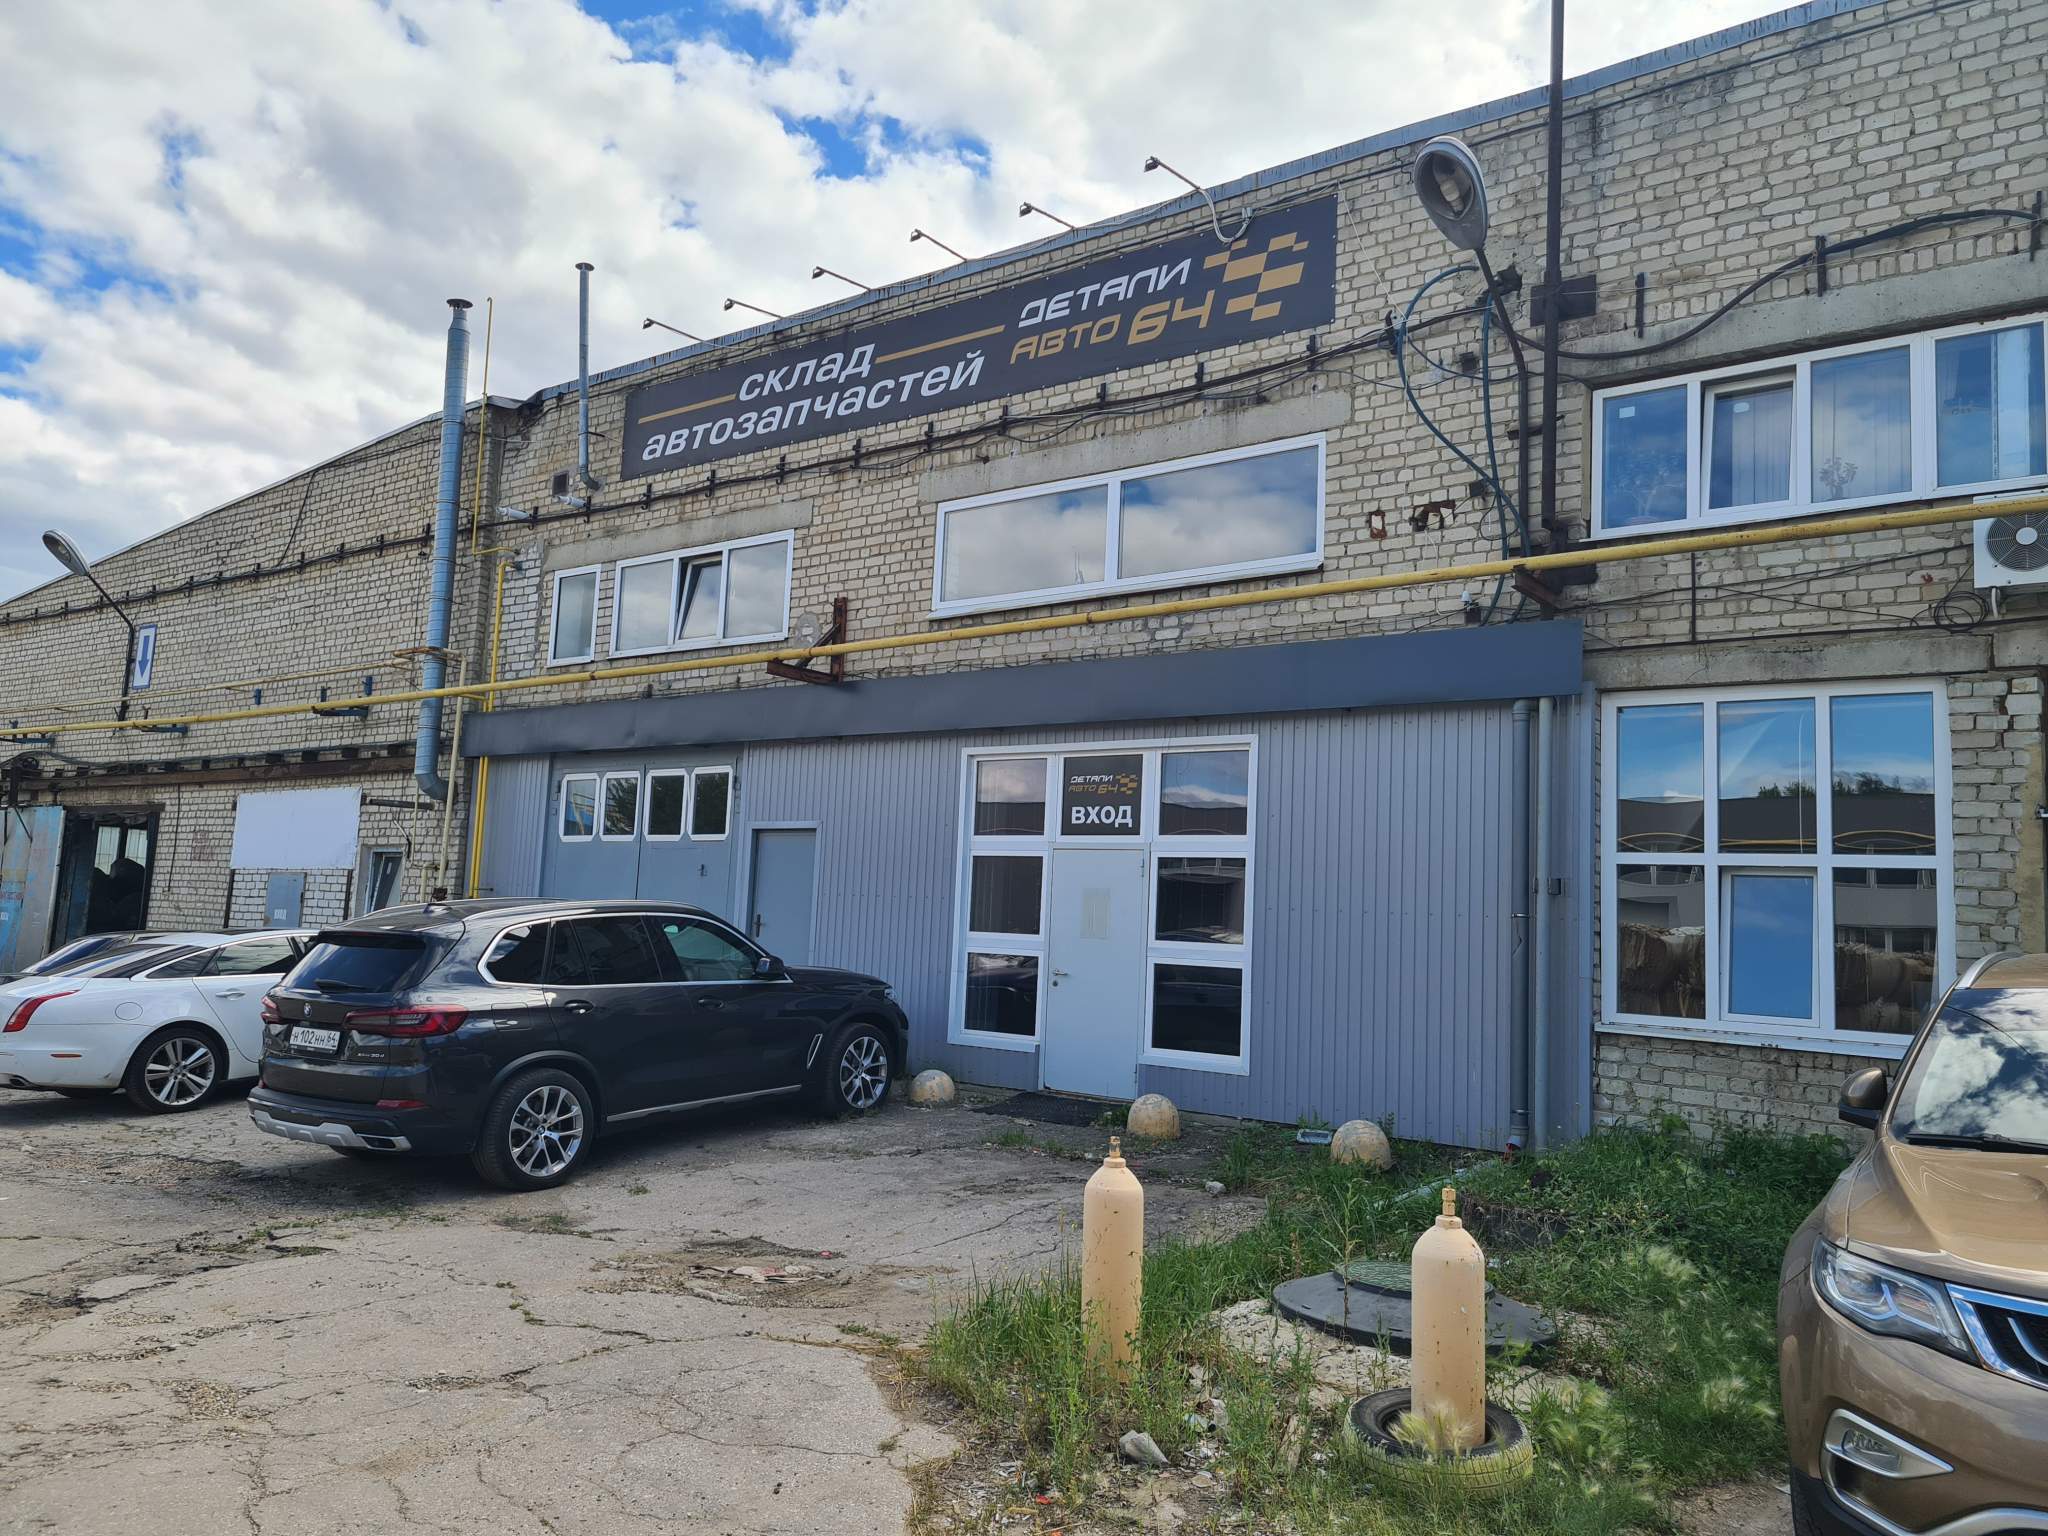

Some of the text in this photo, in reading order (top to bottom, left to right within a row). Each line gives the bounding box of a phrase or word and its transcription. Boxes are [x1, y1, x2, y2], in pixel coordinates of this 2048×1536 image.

[1018, 258, 1192, 328] ДЕТАЛИ
[1009, 289, 1215, 365] АВТО 64
[642, 350, 985, 461] автозапчастей
[1068, 783, 1119, 795] АВТО 64
[1070, 774, 1114, 783] ДЕТАЛИ
[1071, 805, 1133, 828] ВХОД
